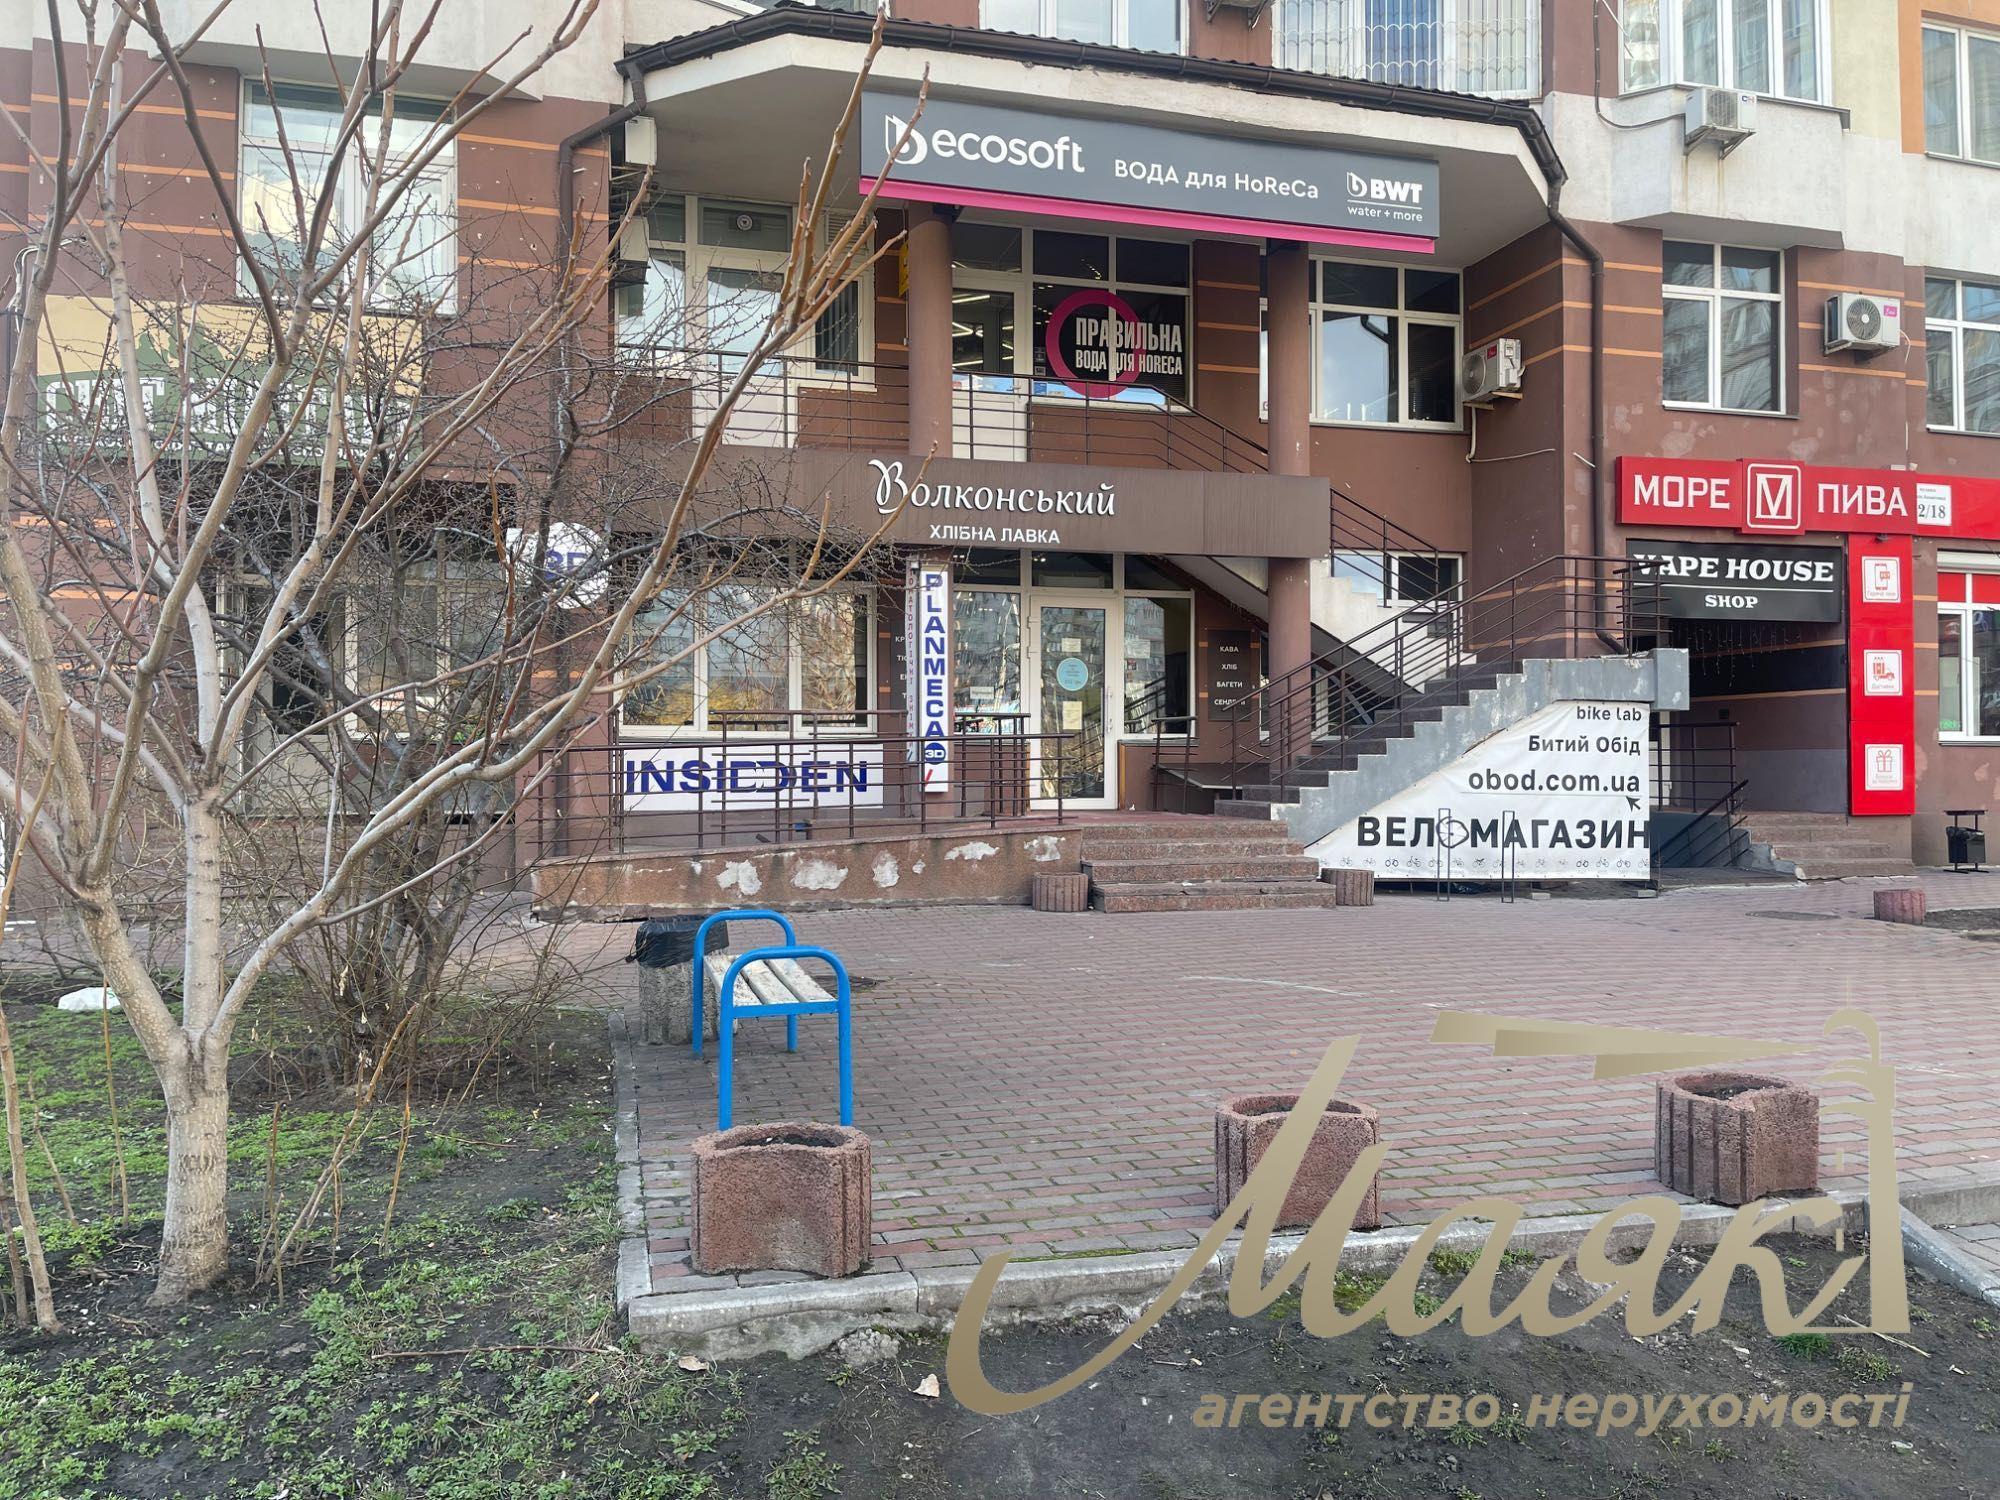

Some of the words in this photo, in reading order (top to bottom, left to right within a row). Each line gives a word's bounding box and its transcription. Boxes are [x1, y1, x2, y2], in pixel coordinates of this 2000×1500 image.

[931, 129, 1085, 173] ecosoft
[1114, 159, 1179, 186] ВОДА
[1185, 171, 1227, 189] для
[1235, 173, 1319, 199] HoReCa
[1370, 178, 1423, 203] BWT
[1347, 206, 1381, 218] water
[1393, 210, 1423, 222] more
[1075, 317, 1183, 353] ПРАВИЛЬНА
[1075, 349, 1107, 372] ВОДА
[1139, 354, 1183, 375] HORECA
[868, 458, 1115, 516] Волконський
[1633, 474, 1730, 510] МОРЕ
[1817, 483, 1909, 517] ПИВА
[1918, 503, 1946, 519] 2/18
[930, 524, 996, 541] ХЛІБНА
[1001, 527, 1060, 544] ЛАВКА
[1633, 554, 1719, 578] VAPE
[1725, 558, 1834, 582] HOUSE
[1705, 594, 1759, 608] SHOP
[924, 574, 946, 738] PLANMECA
[1576, 706, 1611, 721] bike
[1617, 706, 1642, 722] lab
[925, 749, 945, 758] 3D
[1528, 735, 1588, 752] Битий
[1596, 736, 1641, 755] Обід
[1468, 768, 1640, 792] obod.com.ua
[1357, 816, 1650, 849] ВЕЛОМАГАЗИН
